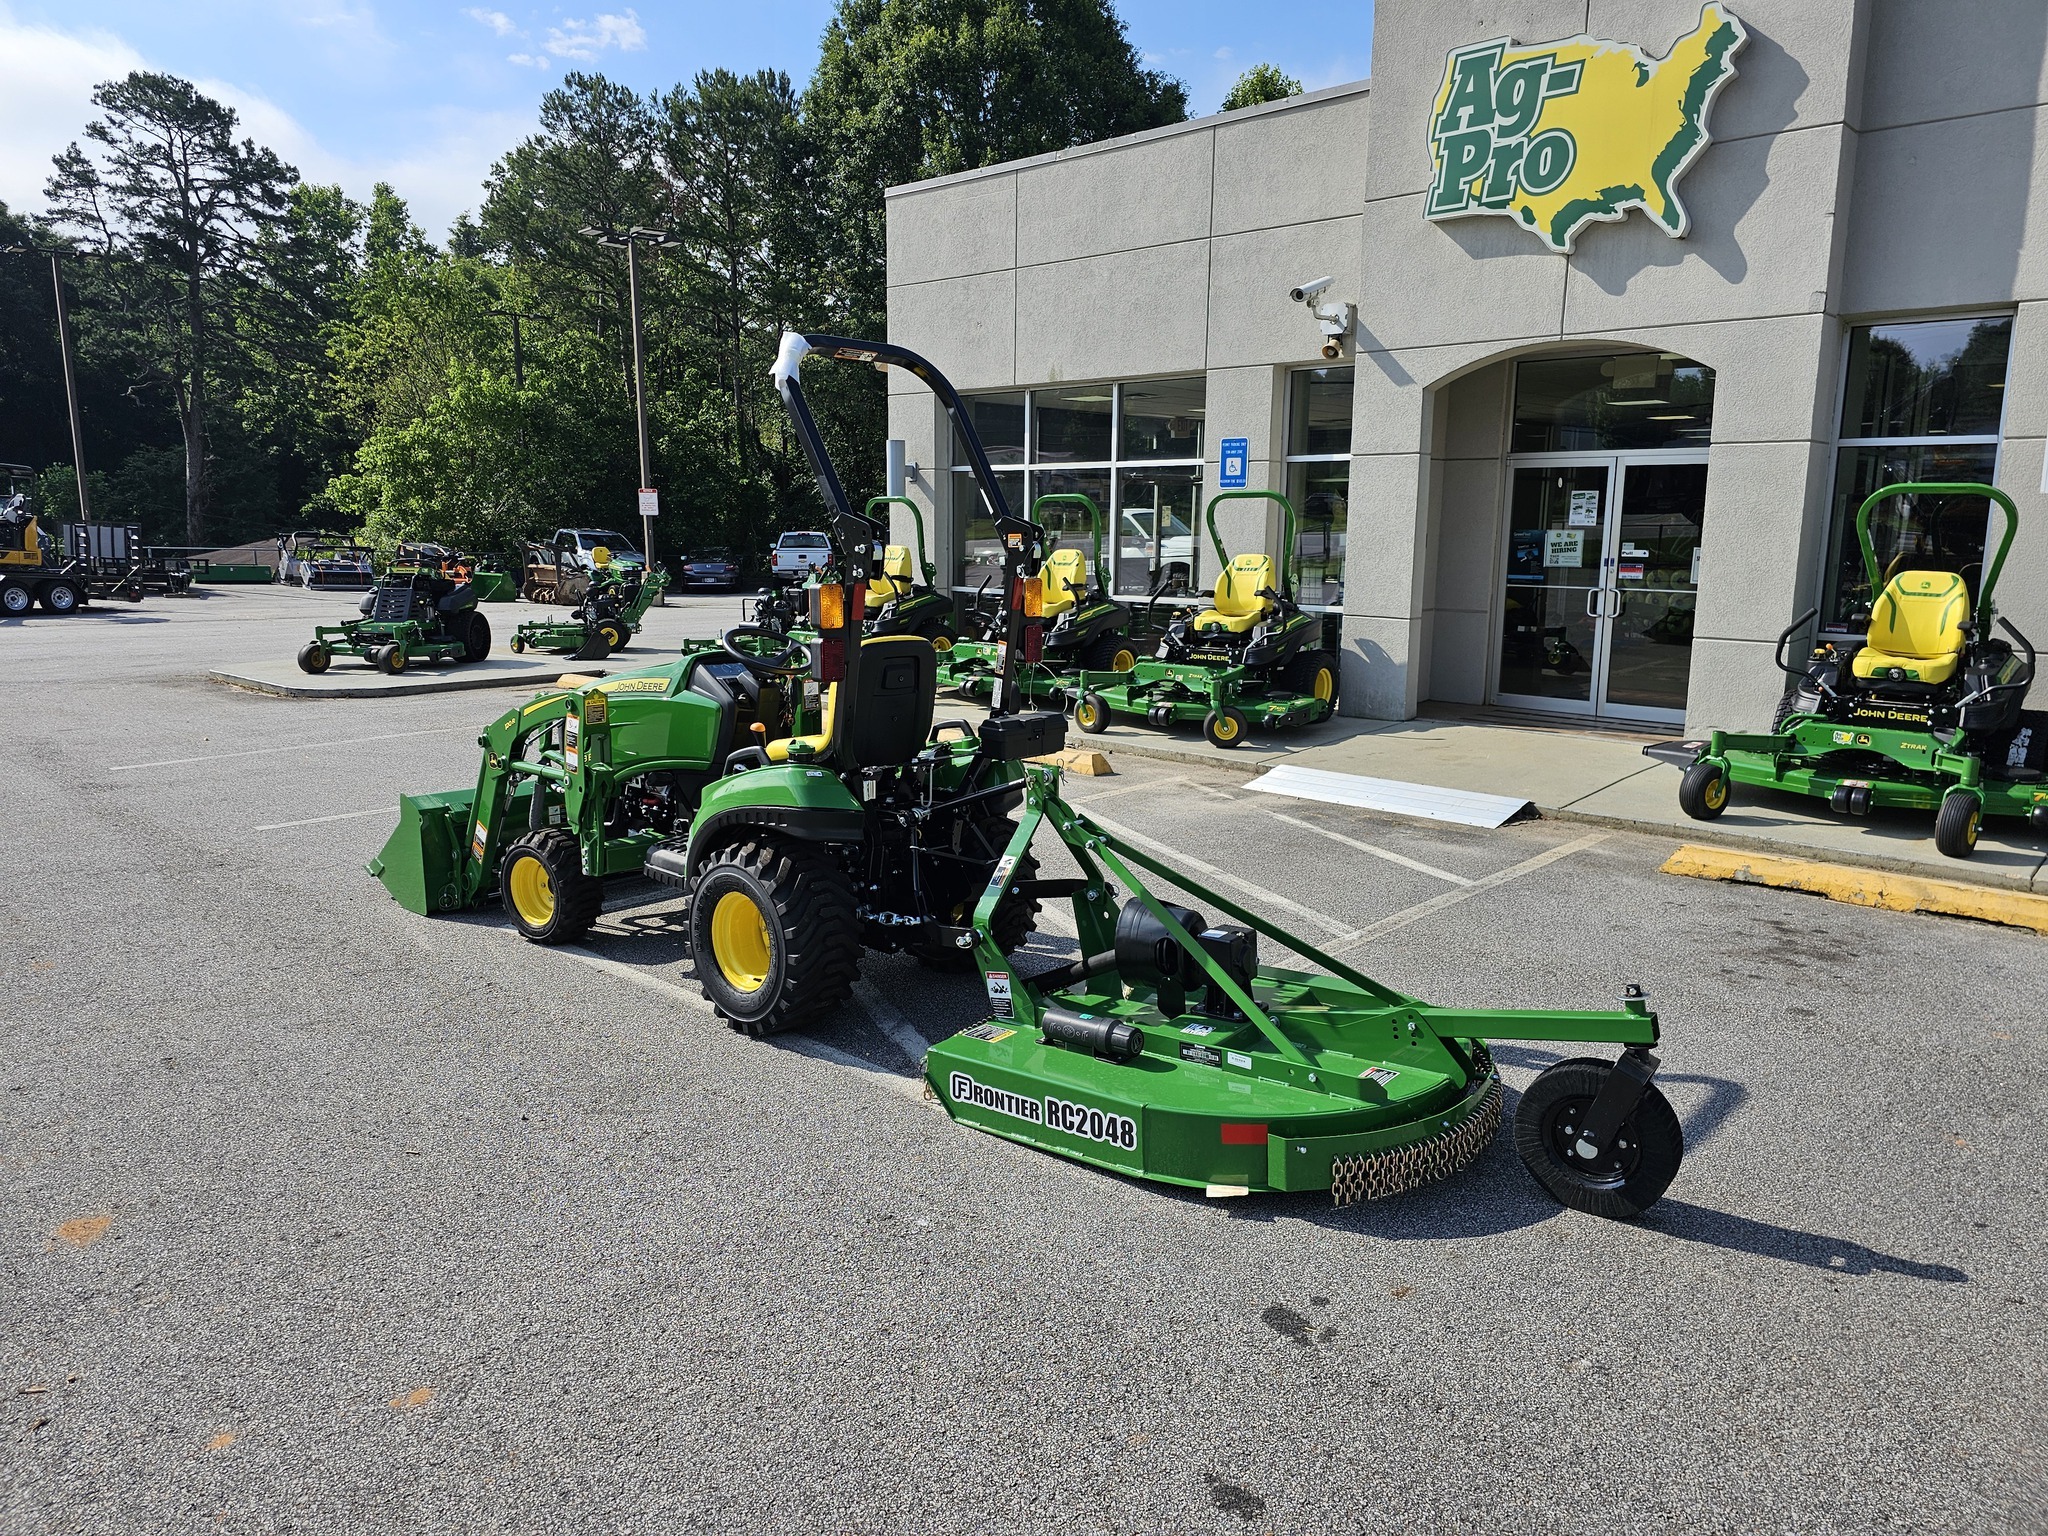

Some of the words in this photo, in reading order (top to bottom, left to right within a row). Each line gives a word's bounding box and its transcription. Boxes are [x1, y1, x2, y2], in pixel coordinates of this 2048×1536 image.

[1432, 42, 1586, 142] Ag-
[1428, 127, 1577, 215] Pro
[1208, 654, 1230, 662] DEERE
[615, 681, 636, 691] JOHN
[636, 681, 664, 691] DEERE
[1853, 707, 1885, 719] JOHN
[1888, 710, 1929, 723] DEERE
[952, 1073, 1041, 1122] FRONTIER
[1047, 1098, 1135, 1149] RC2048
